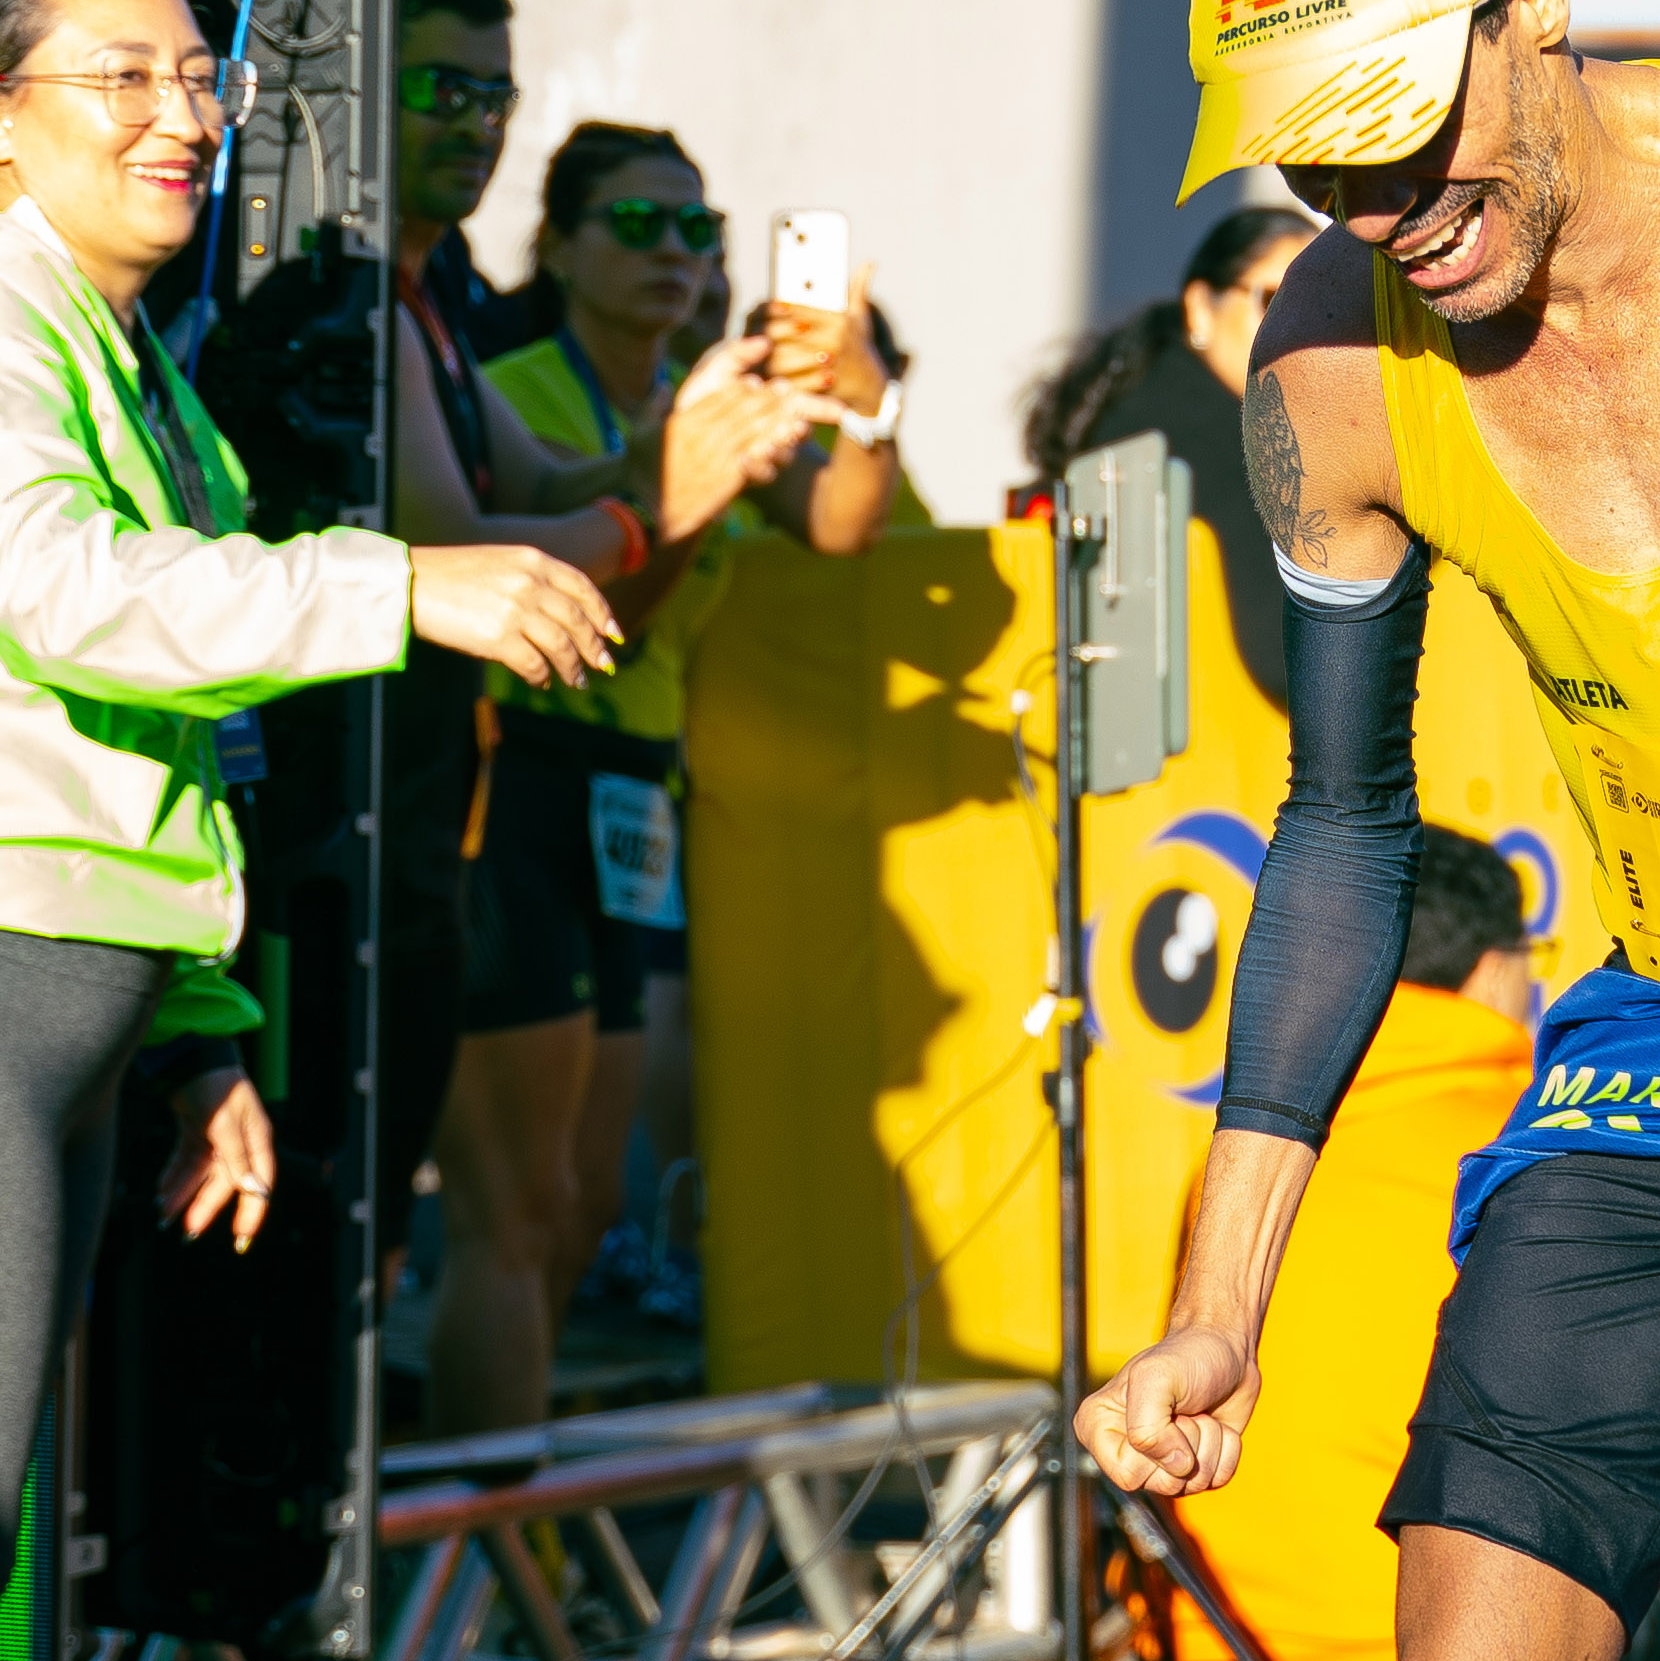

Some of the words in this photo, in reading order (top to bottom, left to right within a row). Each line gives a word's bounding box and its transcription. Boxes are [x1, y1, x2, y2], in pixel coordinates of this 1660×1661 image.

[1217, 10, 1290, 46] PERCURSO
[1549, 675, 1630, 710] ATLETA
[1619, 848, 1645, 910] ELITE
